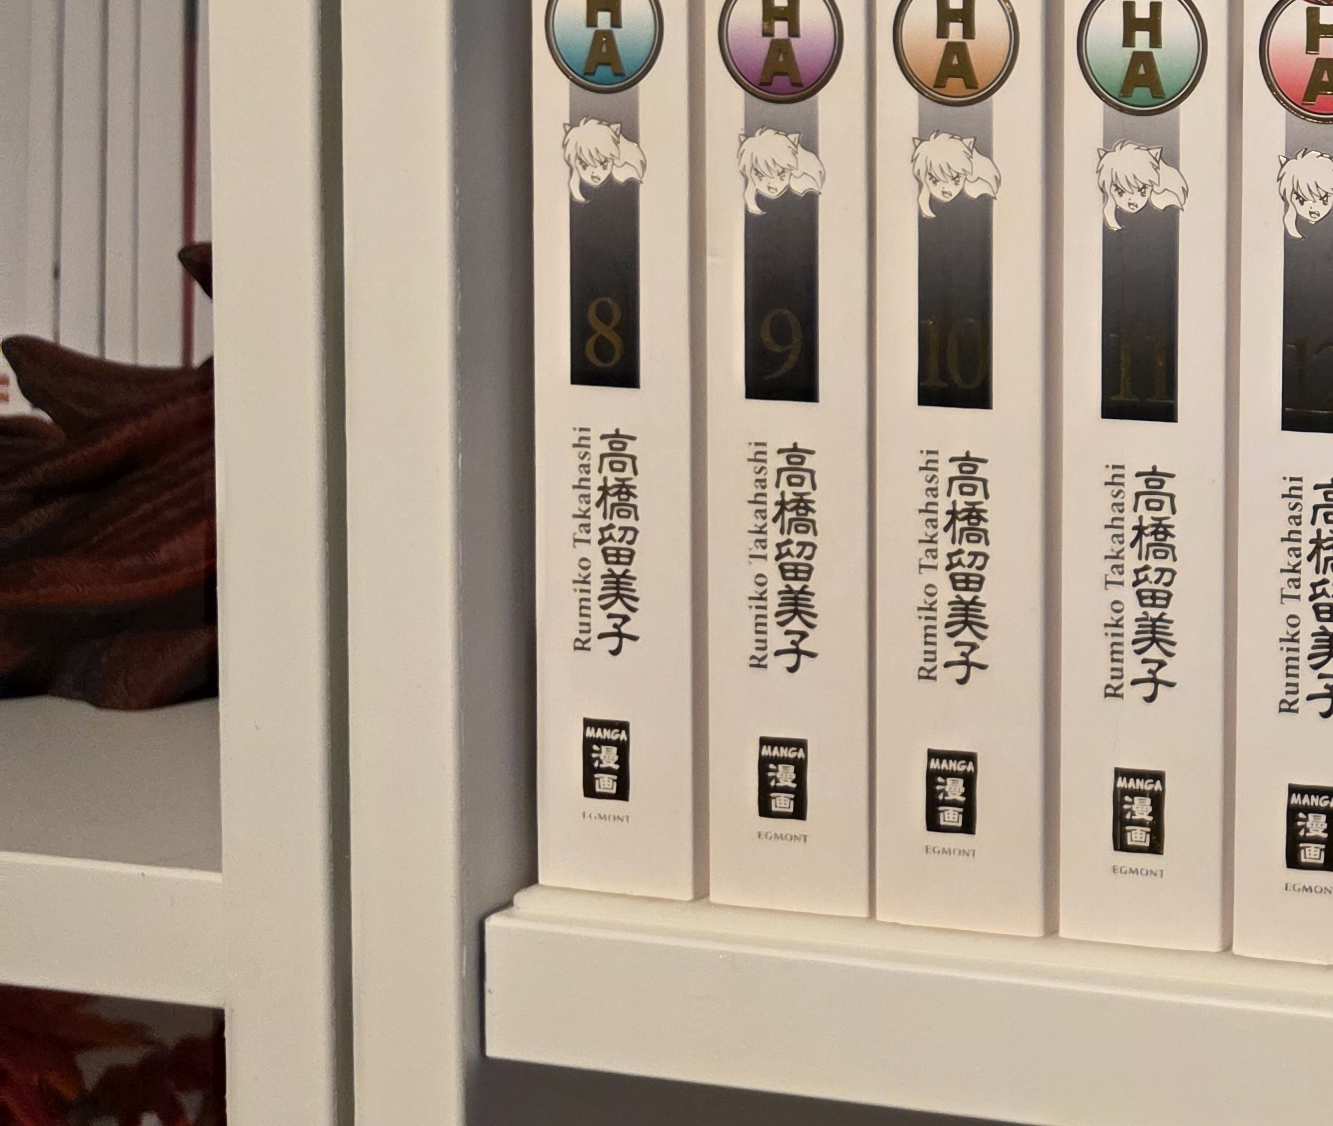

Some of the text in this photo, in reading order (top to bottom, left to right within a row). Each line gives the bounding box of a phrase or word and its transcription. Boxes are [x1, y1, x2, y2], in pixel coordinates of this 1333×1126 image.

[585, 296, 622, 368] 8
[760, 307, 802, 380] 9
[921, 316, 989, 390] 10
[1109, 332, 1176, 403] 11
[572, 427, 591, 651] Rumiko Takahashi
[595, 428, 639, 656] 高橋留美子
[747, 442, 768, 669] Rumiko Takahashi
[772, 442, 818, 673] 高橋留美子
[917, 450, 939, 681] Rumiko Takahashi
[943, 451, 990, 685] 高橋留美子
[1104, 465, 1125, 700] Rumiko Takahashi
[1130, 465, 1177, 703] 高橋留美子
[1279, 477, 1303, 714] Rumiko Takahashi
[585, 726, 628, 741] MANGA
[761, 746, 805, 758] MANGA
[930, 758, 974, 772] MANGA
[582, 811, 629, 823] EGMONT
[1117, 777, 1162, 791] MANGA
[757, 831, 808, 843] EGMONT
[925, 845, 976, 858] EGMONT
[1112, 865, 1163, 878] EGMONT
